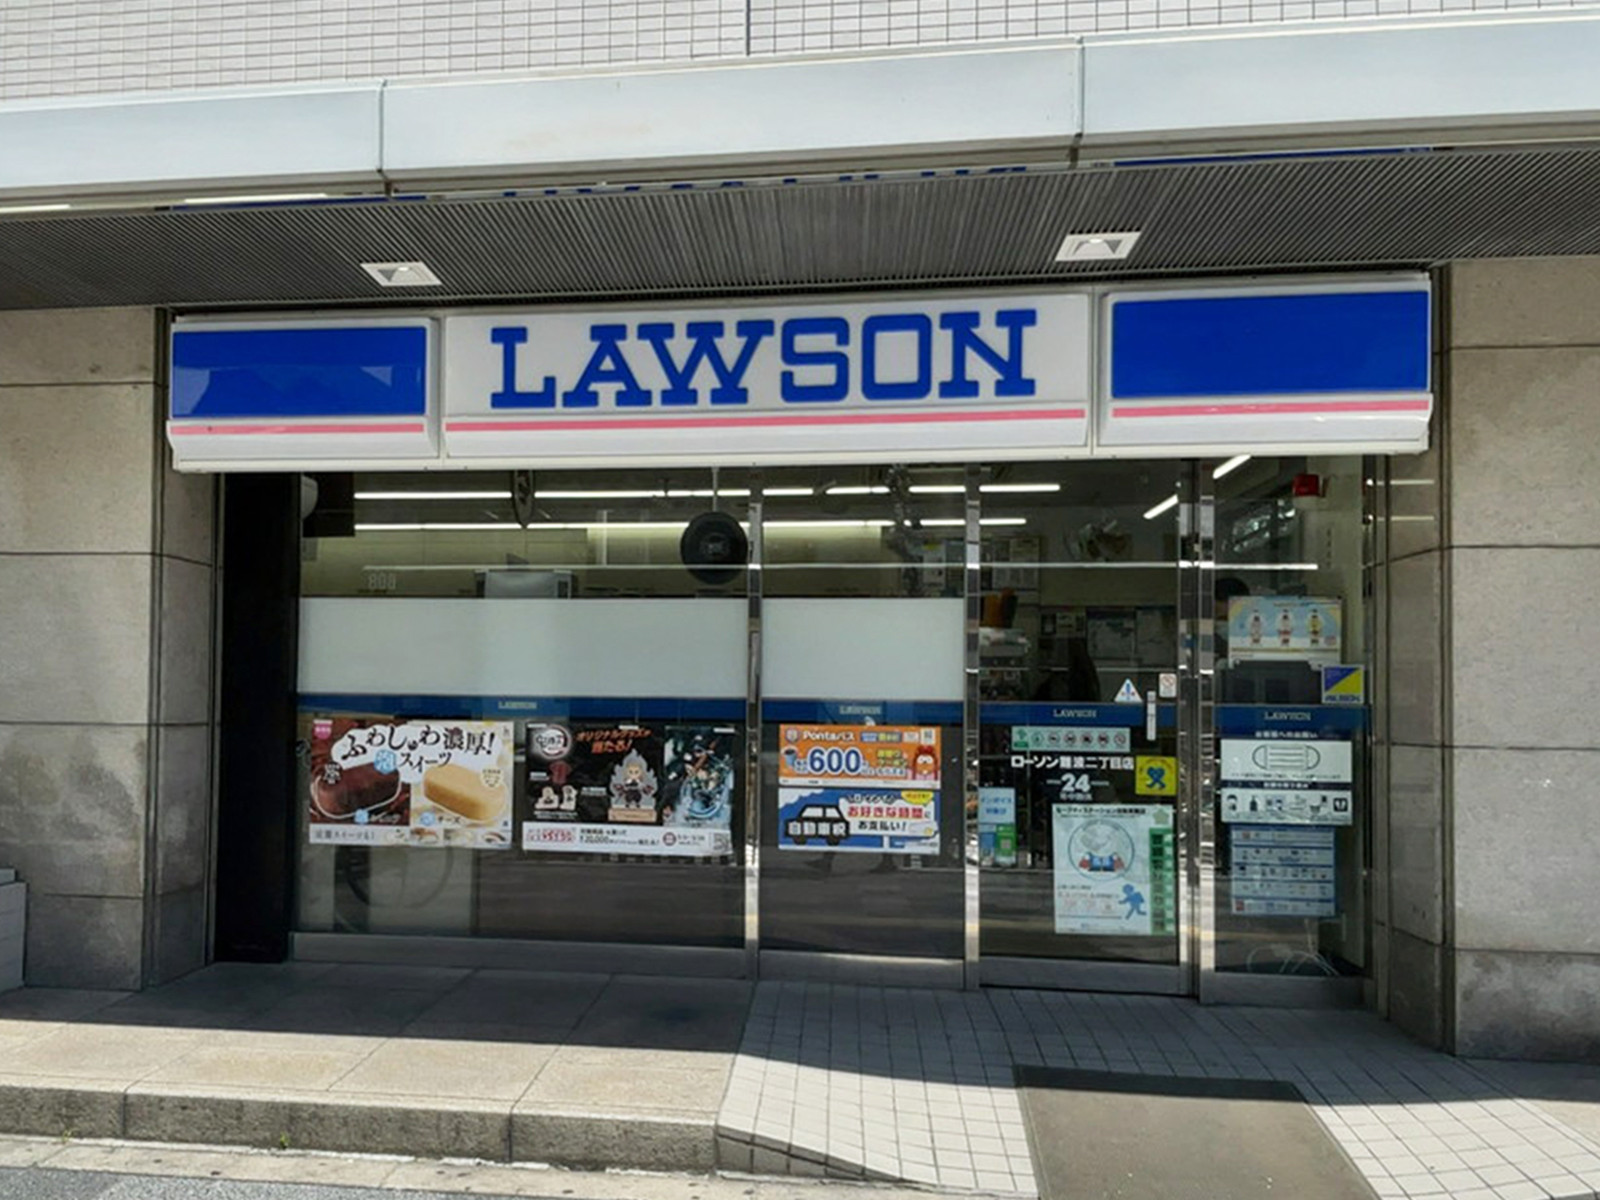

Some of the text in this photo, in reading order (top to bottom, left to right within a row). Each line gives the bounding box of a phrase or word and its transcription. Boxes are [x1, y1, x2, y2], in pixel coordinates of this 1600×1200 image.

[490, 308, 1037, 410] LAWSON
[1053, 709, 1097, 718] LAWSON
[1264, 711, 1311, 720] LAWSON
[809, 747, 862, 774] 600
[1061, 773, 1091, 792] 24
